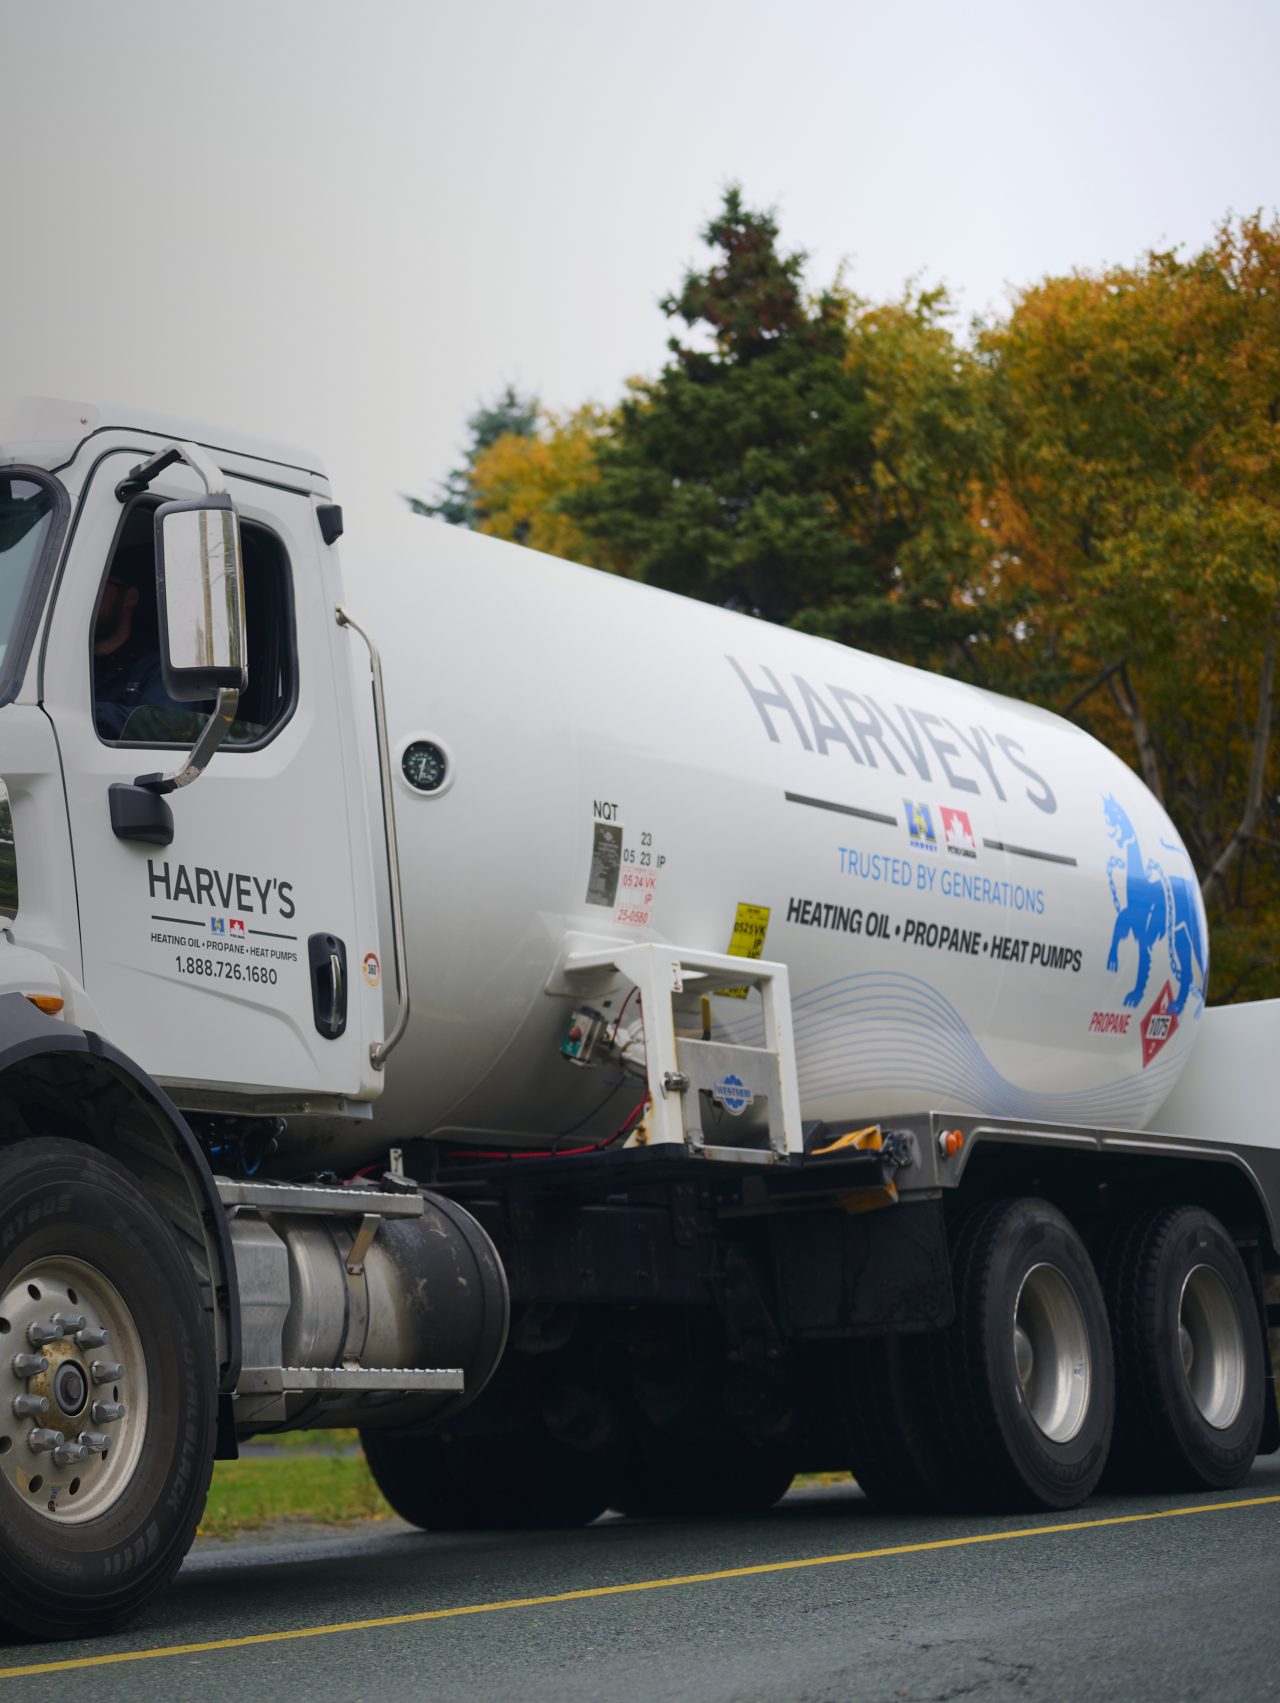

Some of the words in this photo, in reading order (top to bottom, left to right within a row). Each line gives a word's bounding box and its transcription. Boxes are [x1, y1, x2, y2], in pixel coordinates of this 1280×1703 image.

[725, 654, 1058, 815] HARVEY'S
[593, 800, 618, 821] NQT
[641, 832, 652, 846] 23
[623, 848, 635, 863] 05
[640, 851, 651, 866] 23
[657, 855, 666, 869] IP
[147, 859, 296, 919] HARVEY'S
[838, 847, 913, 888] TRUSTED
[917, 864, 937, 891] BY
[941, 870, 1045, 914] GENERATIONS
[151, 932, 187, 948] HEATING
[188, 938, 201, 948] OIL
[206, 940, 245, 955] PROPANE
[250, 946, 269, 958] HEAT
[270, 949, 298, 962] PUMPS
[786, 897, 863, 936] HEATING
[865, 914, 891, 940] OIL
[903, 919, 981, 956] PROPANE
[990, 935, 1030, 961] HEAT
[1032, 943, 1083, 972] PUMPS
[175, 956, 278, 985] 1.888.726.1680
[1088, 1012, 1132, 1034] PROPANE
[1148, 1017, 1170, 1037] 1075
